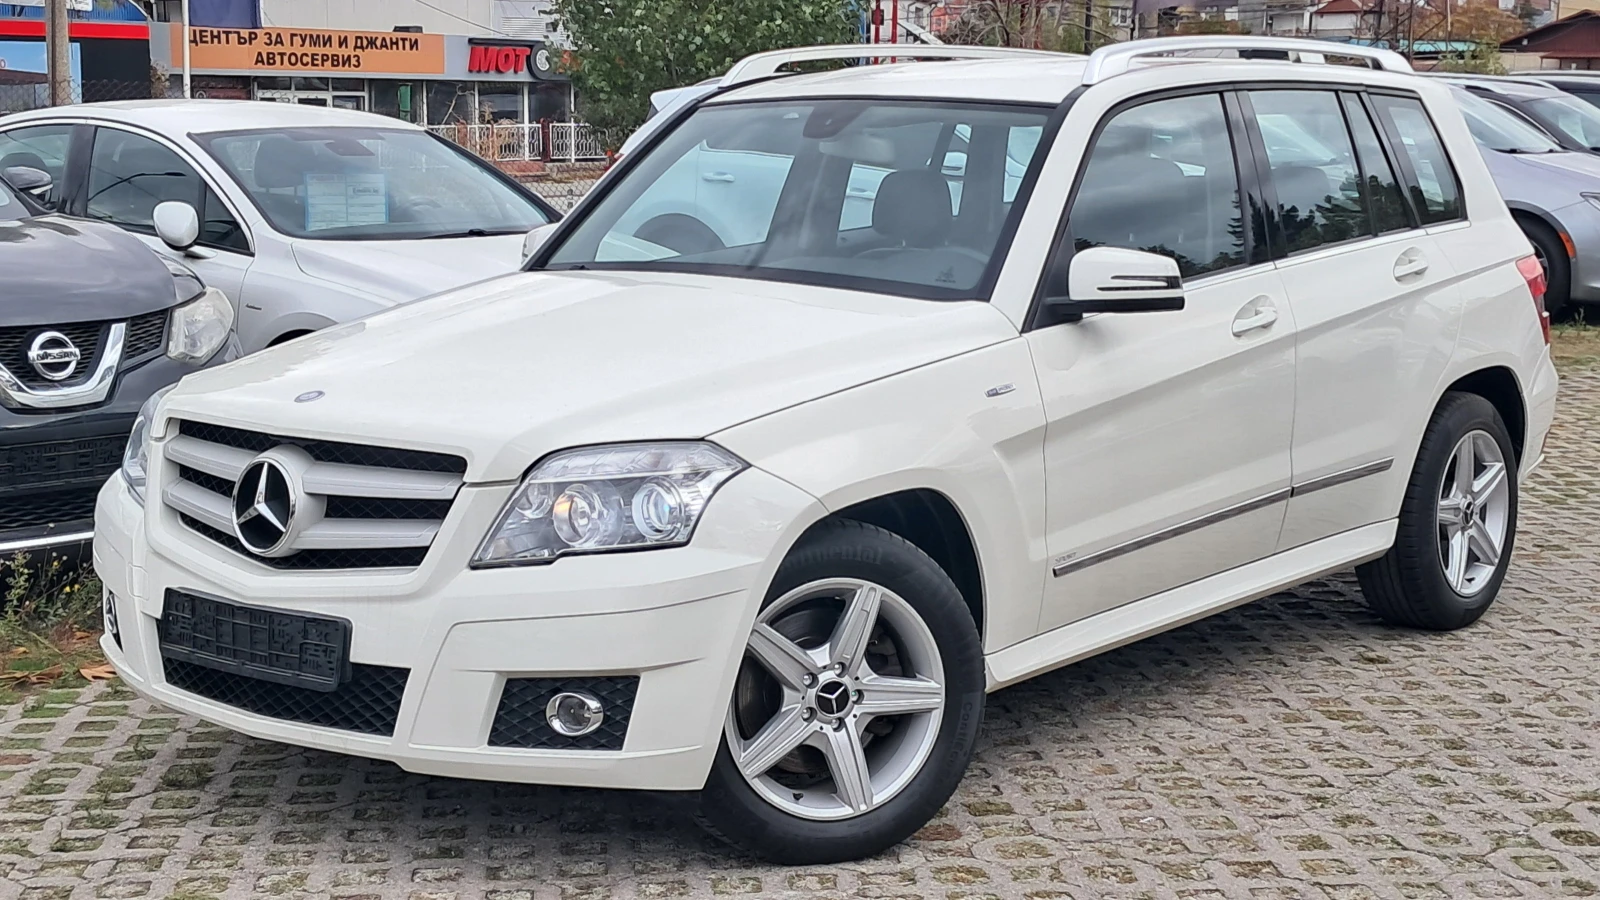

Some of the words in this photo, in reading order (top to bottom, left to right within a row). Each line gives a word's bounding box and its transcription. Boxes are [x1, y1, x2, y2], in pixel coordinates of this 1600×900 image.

[263, 32, 284, 47] ЗА
[289, 33, 332, 49] ГУМИ
[338, 35, 348, 49] И
[353, 36, 419, 52] ДЖАНТИ
[254, 51, 361, 69] АВТОСЕРВИЗ
[36, 350, 79, 361] NISSAN
